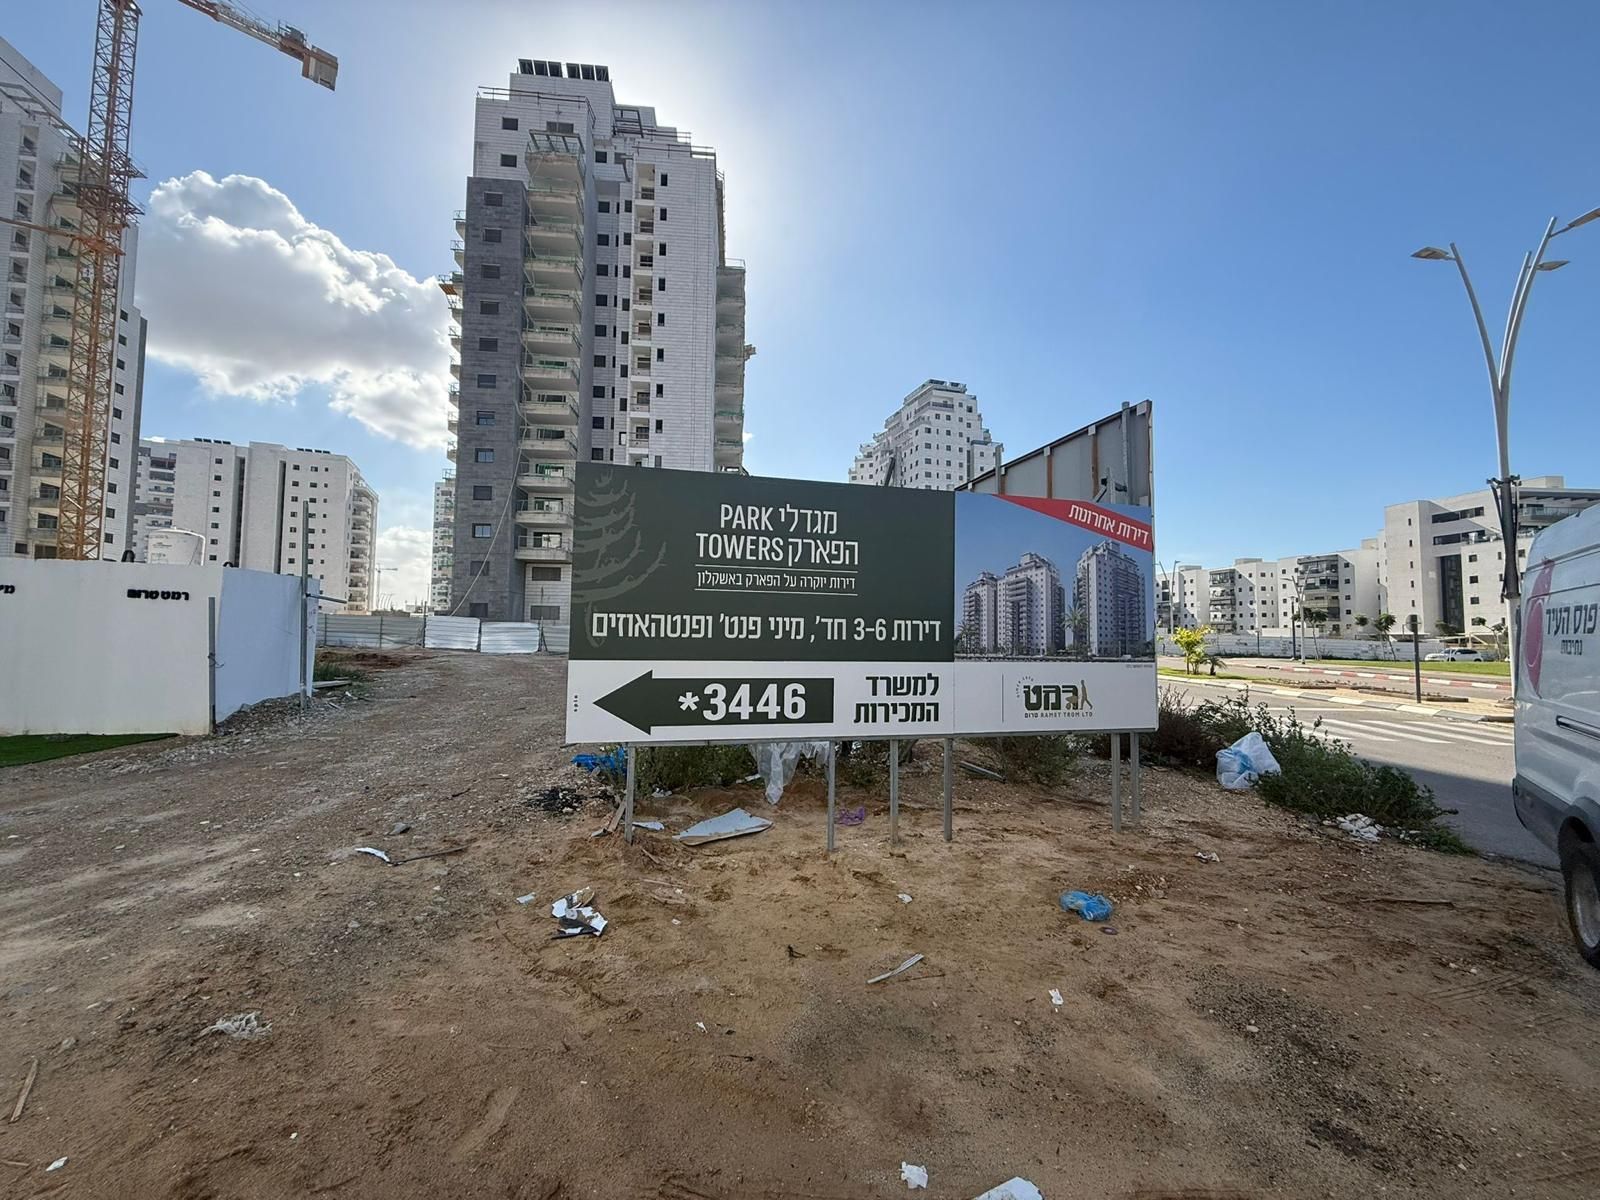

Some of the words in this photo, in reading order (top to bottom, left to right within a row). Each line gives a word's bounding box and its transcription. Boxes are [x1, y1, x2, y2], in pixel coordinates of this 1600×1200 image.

[720, 504, 774, 531] PARK
[778, 503, 838, 534] מגדלי
[1068, 504, 1116, 533] אחרונות
[1117, 521, 1150, 545] דירות
[695, 532, 784, 562] TOWERS
[788, 538, 859, 567] הפארק
[696, 570, 743, 587] באשקלון
[745, 573, 781, 588] הפארק
[783, 573, 797, 587] על
[799, 576, 827, 590] יוקרה
[829, 577, 856, 590] דירות
[592, 612, 713, 639] ופנטהאוזים
[768, 616, 805, 640] מיני
[853, 617, 887, 641] 3-6
[891, 619, 942, 642] דירות
[1573, 603, 1600, 635] פוס
[866, 673, 939, 697] למשרד
[853, 702, 940, 723] המכירות
